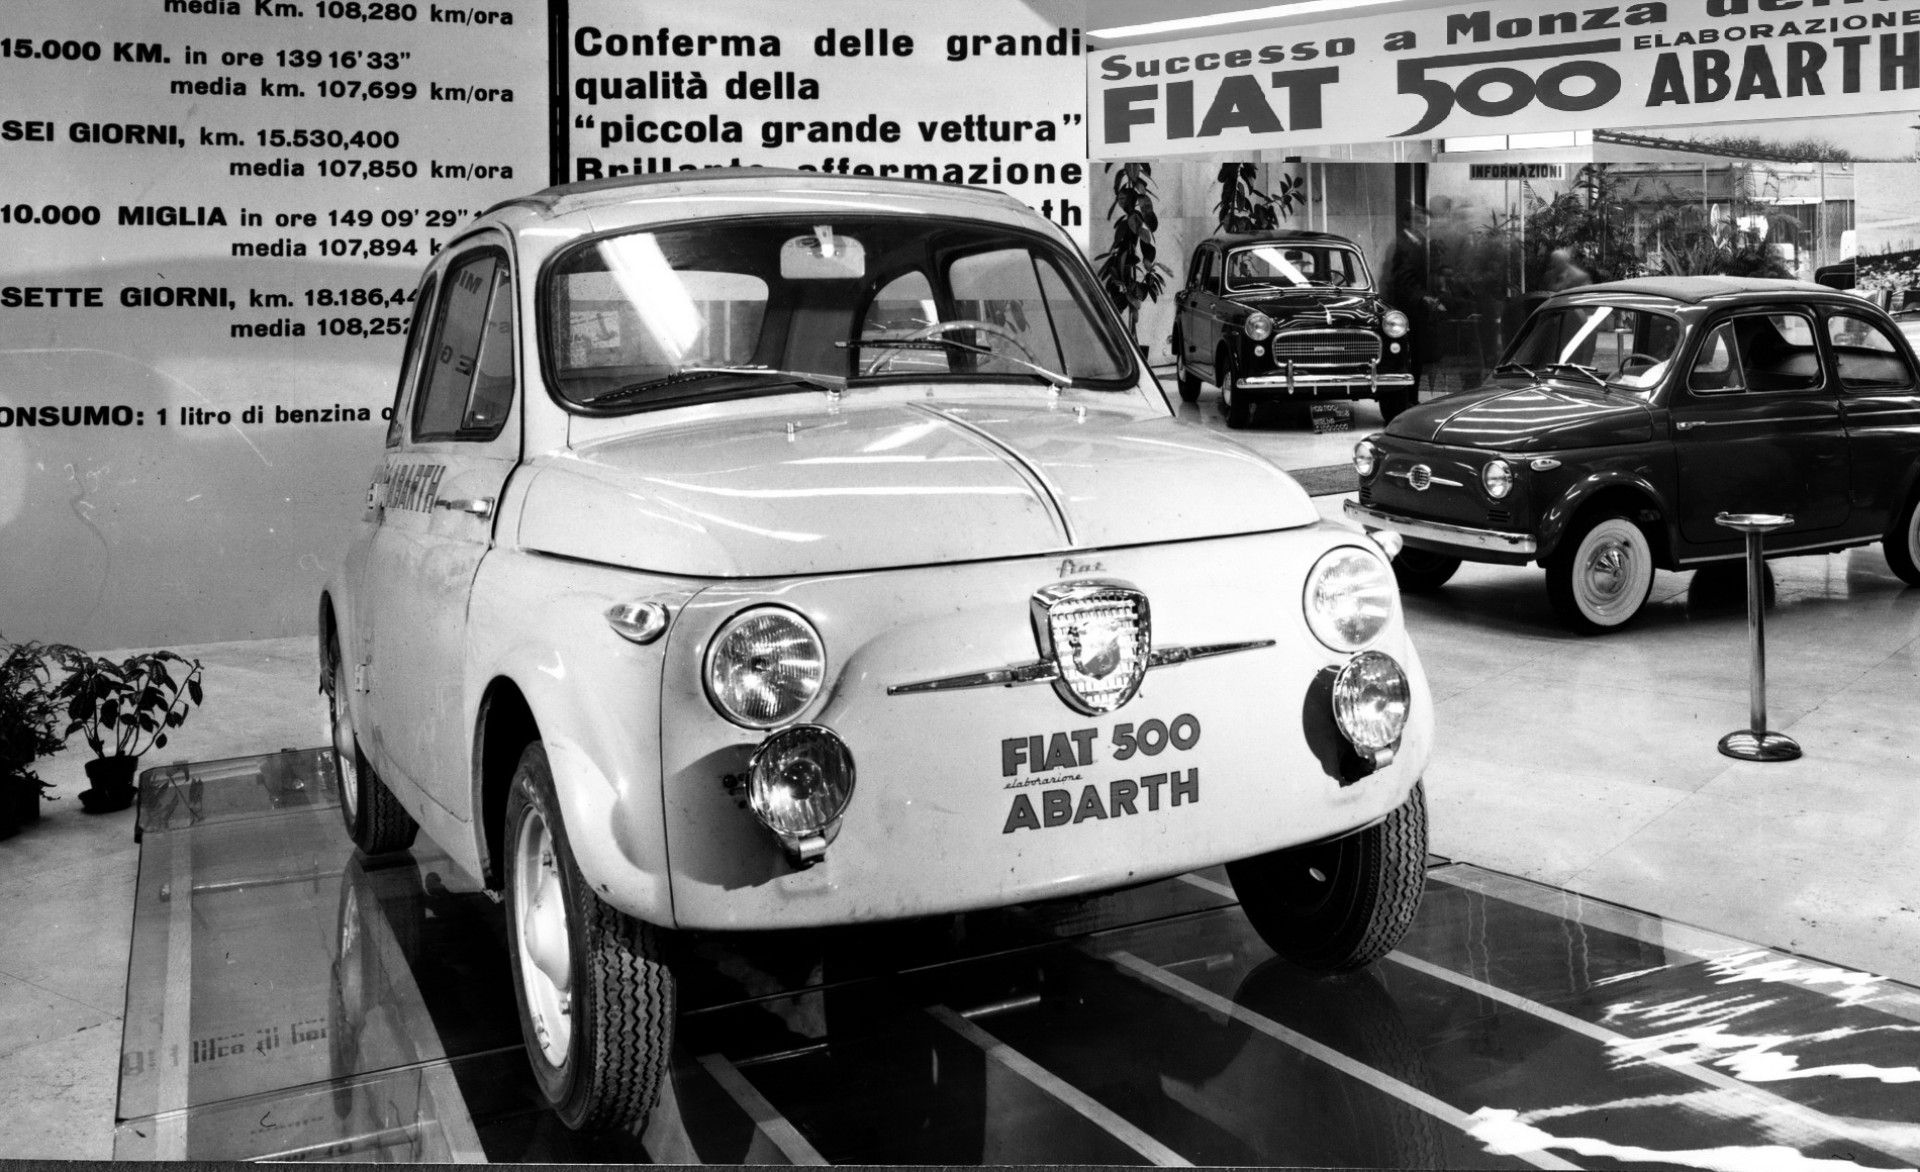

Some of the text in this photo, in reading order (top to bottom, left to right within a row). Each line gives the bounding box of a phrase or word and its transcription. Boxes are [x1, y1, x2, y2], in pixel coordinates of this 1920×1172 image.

[164, 0, 514, 27] media Km. 108,280 km/ora
[574, 26, 1081, 62] Conferma delle grandi
[1100, 0, 1667, 83] Successo a Monza
[1633, 10, 1920, 51] ELABORAZIONE
[0, 37, 102, 62] 15.000
[113, 41, 171, 64] KM.
[184, 44, 208, 66] in
[221, 51, 264, 67] ore
[276, 48, 323, 69] 139
[170, 76, 514, 104] media km. 107,699 km/ora
[575, 70, 820, 106] qualità della
[1104, 30, 1920, 144] FIAT 500 ABARTH
[1, 119, 400, 151] SEI GIORNI, km. 15.530,400
[761, 113, 901, 149] grande
[229, 157, 513, 182] media 107,850 km/ora
[576, 157, 764, 182] Brill
[1472, 165, 1562, 178] INFORMAZIONI
[0, 203, 101, 226] 10.000
[118, 205, 228, 227] MIGLIA
[240, 207, 263, 227] in
[275, 213, 317, 228] ore
[328, 209, 374, 227] 149
[381, 208, 419, 228] 09'
[231, 238, 307, 257] media
[318, 238, 418, 260] 107,894
[0, 286, 104, 308] SETTE
[119, 286, 236, 311] GIORNI,
[249, 288, 294, 308] km.
[230, 318, 306, 338] media
[156, 407, 167, 426] 1
[180, 406, 232, 426] litro
[241, 405, 264, 424] di
[275, 403, 371, 424] benzina
[1001, 713, 1201, 777] FIAT 500
[1002, 767, 1199, 834] ABARTH
